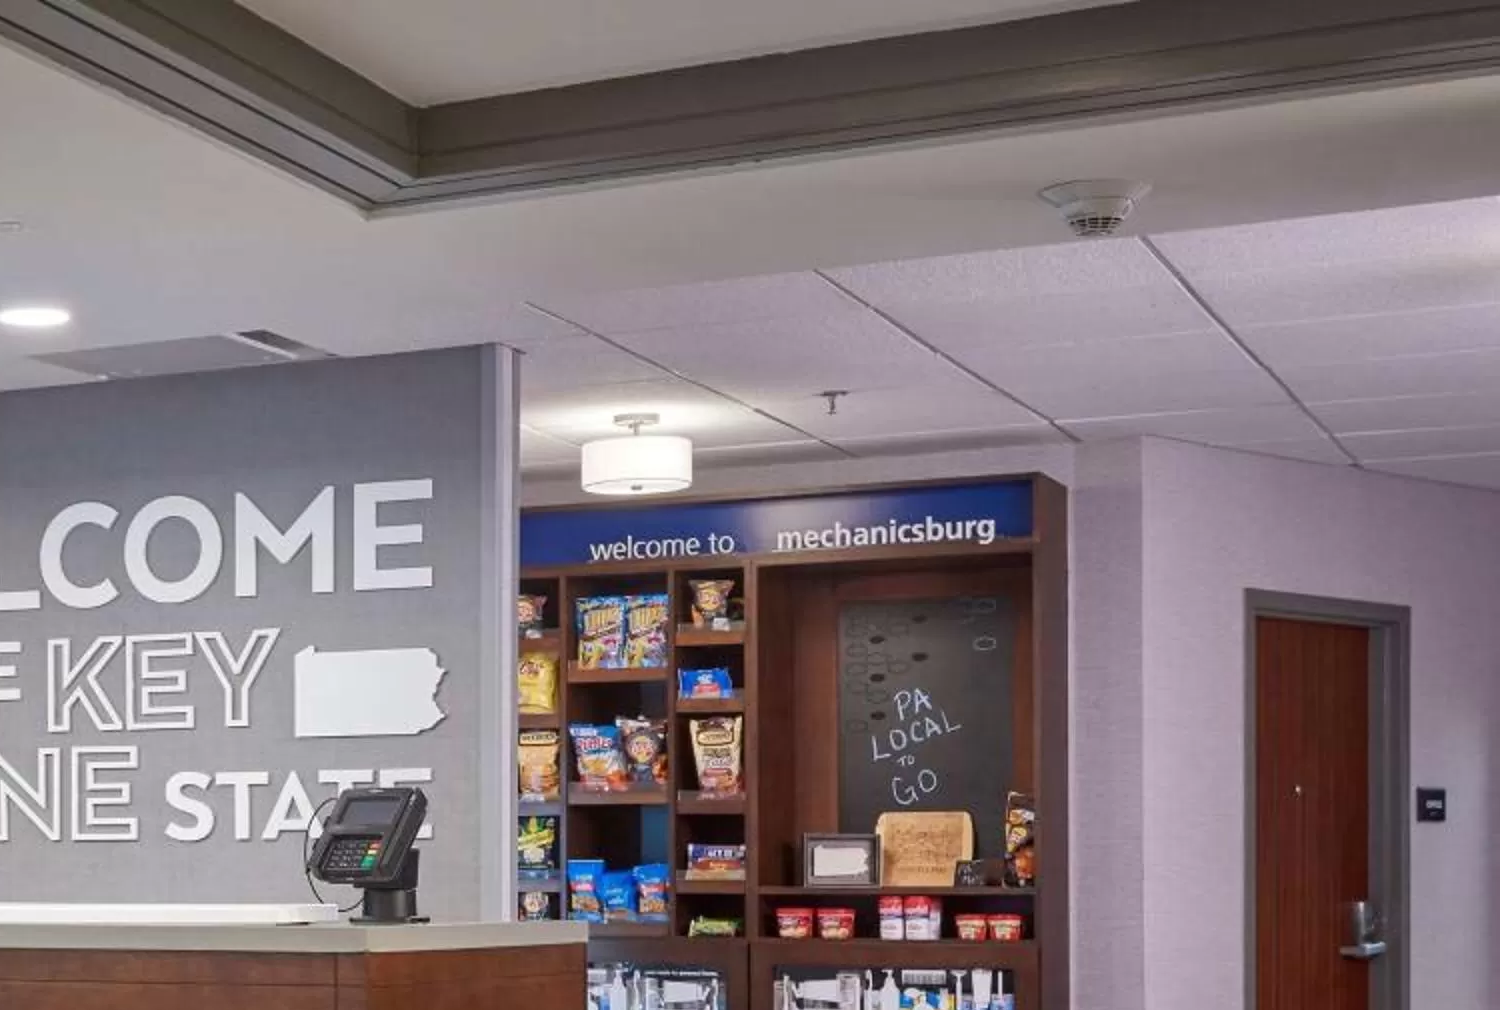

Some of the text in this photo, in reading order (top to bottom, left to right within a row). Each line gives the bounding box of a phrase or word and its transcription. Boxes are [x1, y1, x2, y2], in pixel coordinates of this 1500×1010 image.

[589, 515, 996, 562] welcome to mechanicsburg
[46, 627, 281, 733] KEY
[893, 687, 932, 721] PA
[871, 711, 962, 761] LOCAL
[897, 755, 915, 767] TO
[891, 768, 938, 805] GO
